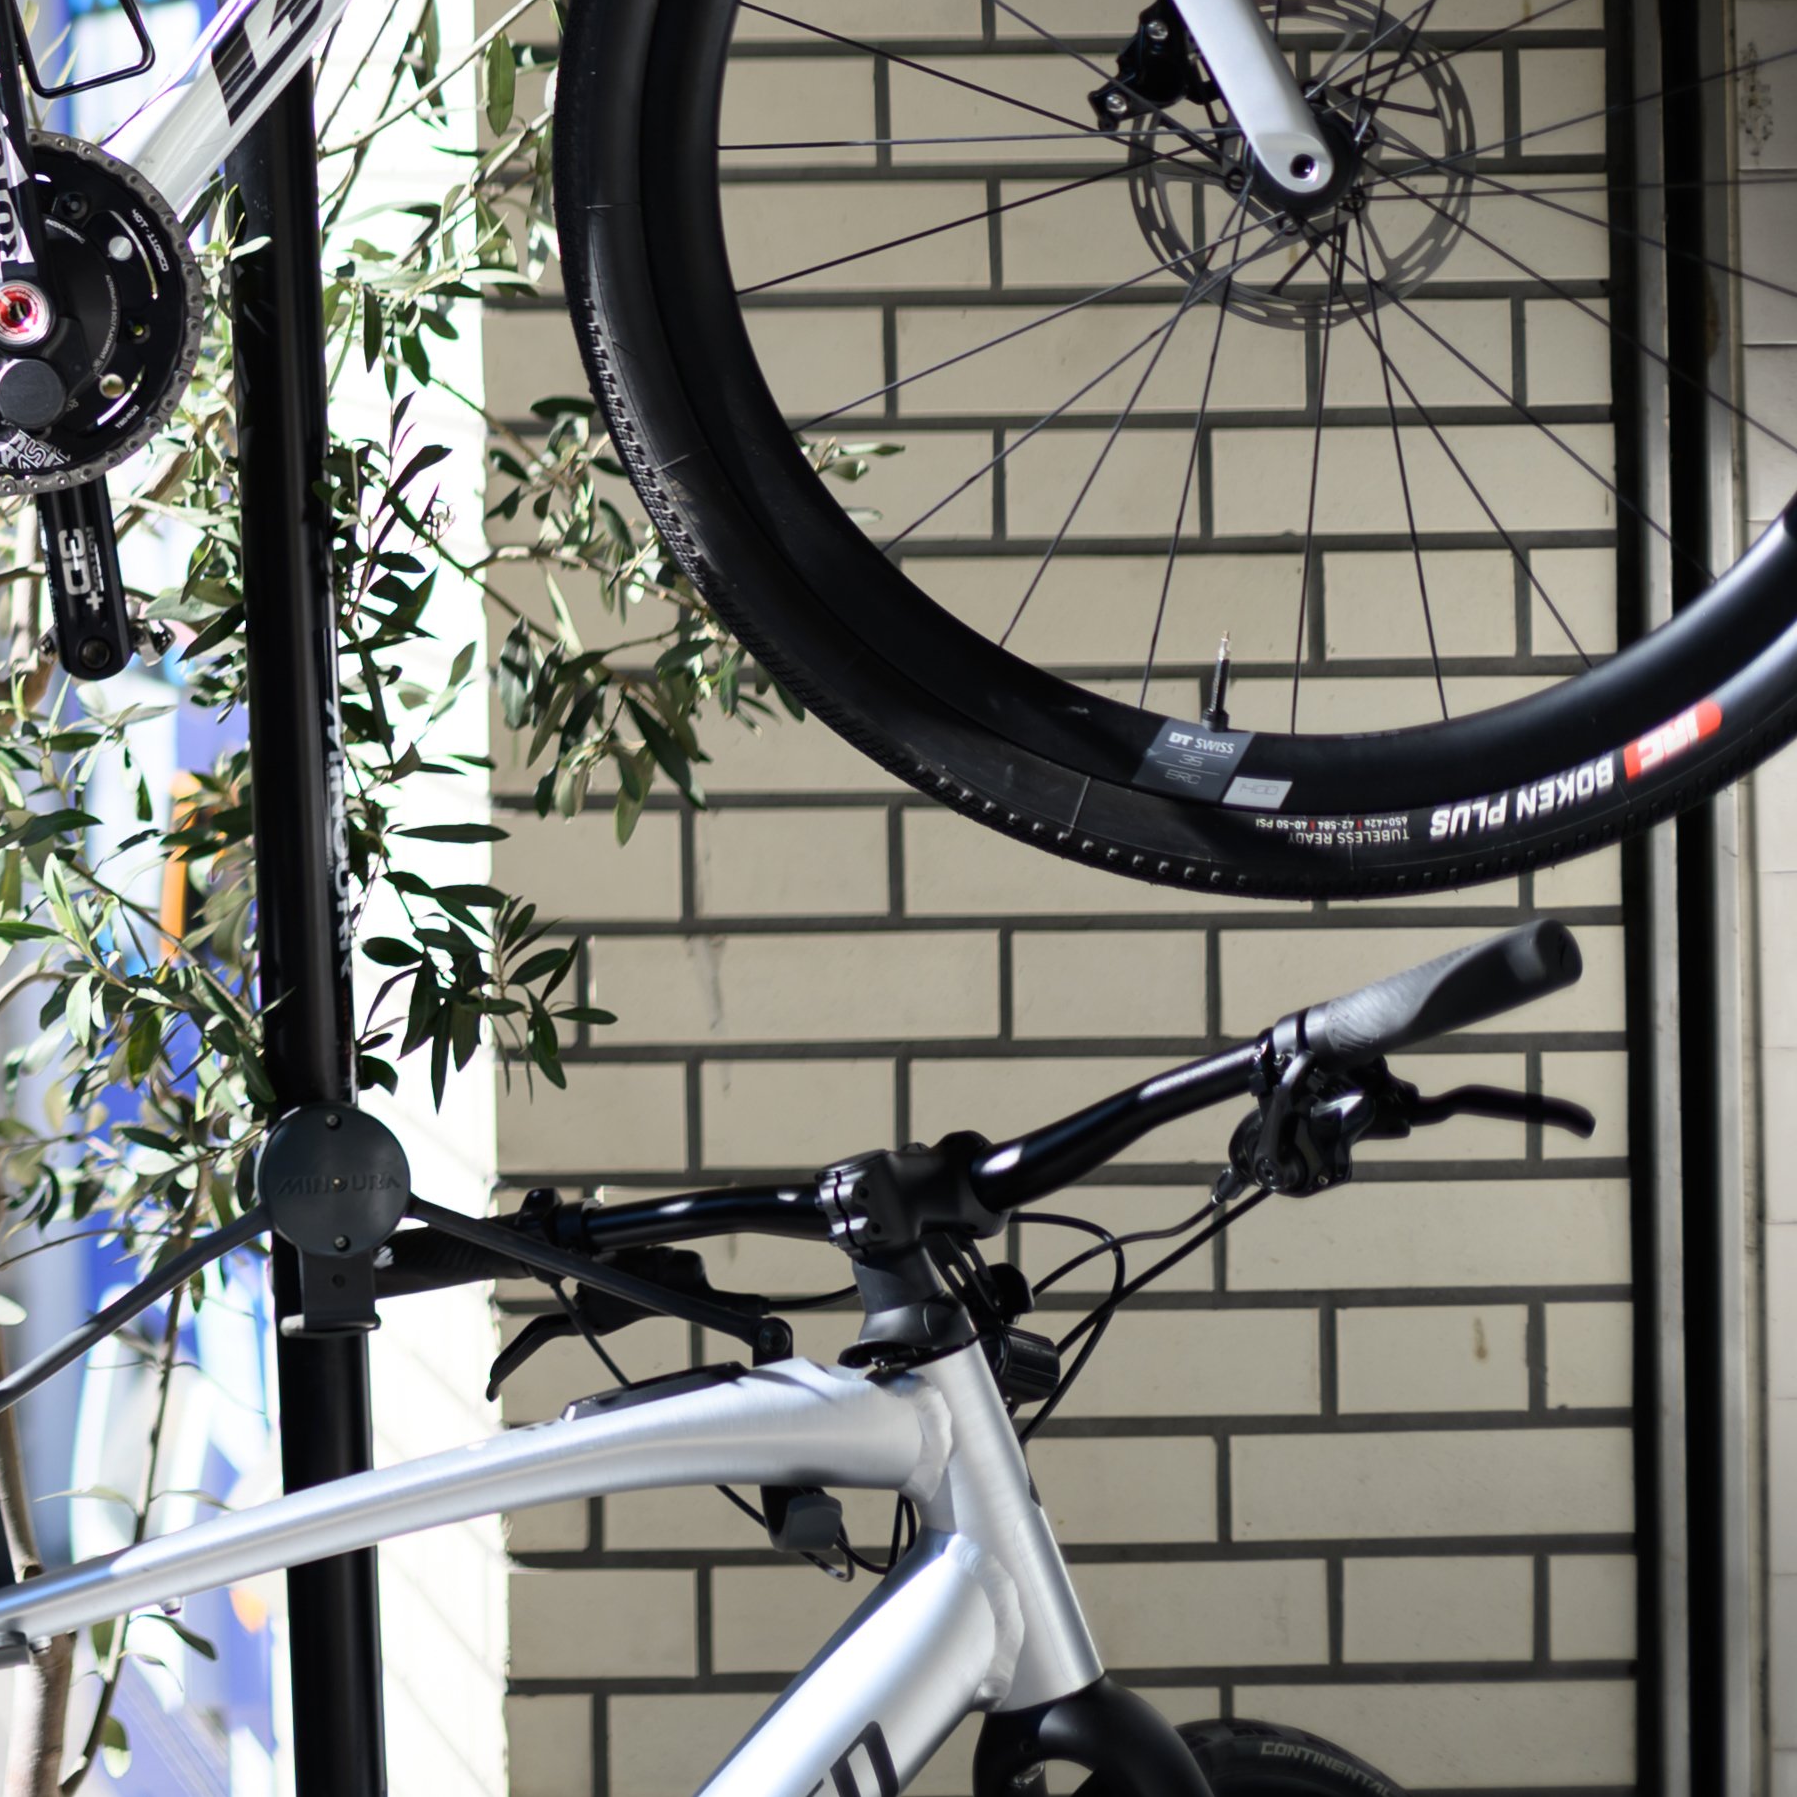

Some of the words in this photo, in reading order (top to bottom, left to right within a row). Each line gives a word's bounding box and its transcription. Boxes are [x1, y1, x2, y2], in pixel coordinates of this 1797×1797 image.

[1168, 731, 1193, 746] DT
[1195, 737, 1235, 755] SWISS
[1637, 709, 1699, 772] IRC
[1178, 753, 1204, 767] 35
[1516, 753, 1615, 819] BOKEN
[1255, 816, 1274, 829] PSI
[1275, 818, 1308, 830] 40-50
[1429, 793, 1509, 840] PLUS
[1287, 831, 1333, 845] READY
[1336, 828, 1411, 845] TUBELESS
